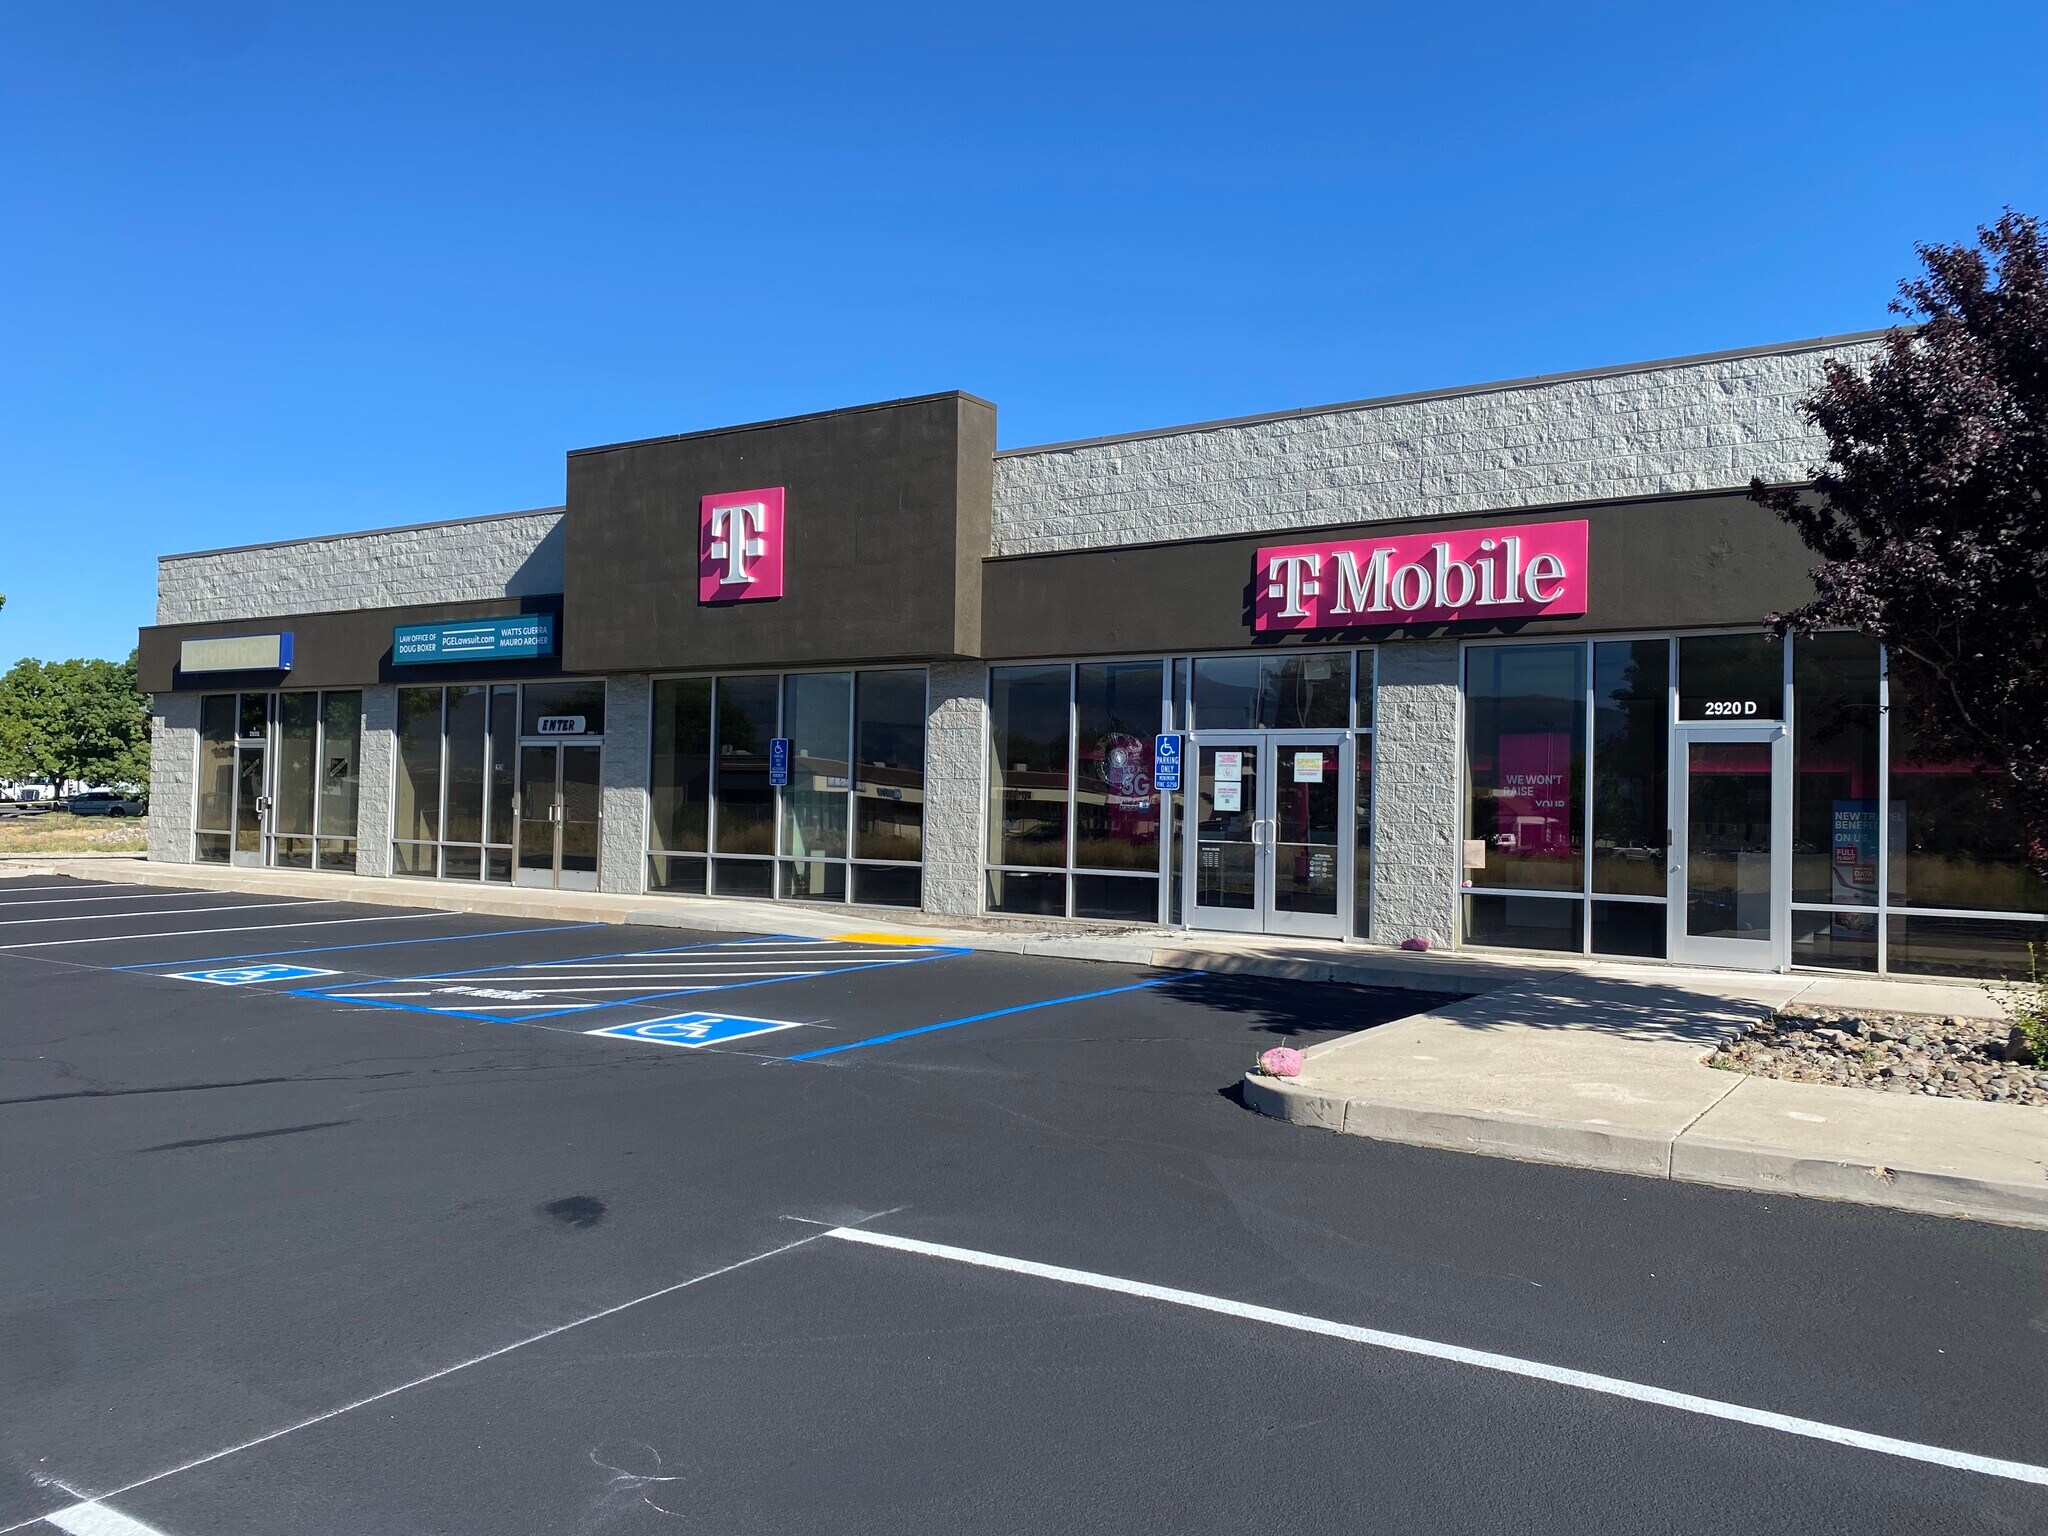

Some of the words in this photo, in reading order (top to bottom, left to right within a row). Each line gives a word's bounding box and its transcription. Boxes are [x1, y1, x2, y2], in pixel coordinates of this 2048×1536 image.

[711, 502, 764, 584] T
[1330, 536, 1566, 612] Mobile
[501, 627, 522, 637] WATTS
[522, 626, 548, 635] GUERRA
[399, 635, 411, 643] LAW
[411, 634, 429, 642] OFFICE
[429, 633, 436, 641] OF
[442, 635, 495, 646] PGELawsuit.com
[500, 638, 523, 647] MAURO
[523, 636, 548, 645] ARCHER
[399, 644, 416, 654] DOUG
[417, 643, 436, 652] BOXER
[1705, 702, 1741, 715] 2920
[1744, 701, 1757, 714] D
[542, 720, 575, 731] ENTER
[1121, 773, 1150, 796] 5G
[1506, 775, 1524, 784] WE
[1525, 775, 1562, 784] WON'T
[1503, 787, 1534, 796] RAISE
[1835, 812, 1860, 820] NEW
[1862, 812, 1903, 821] TREL
[1835, 834, 1851, 842] ON
